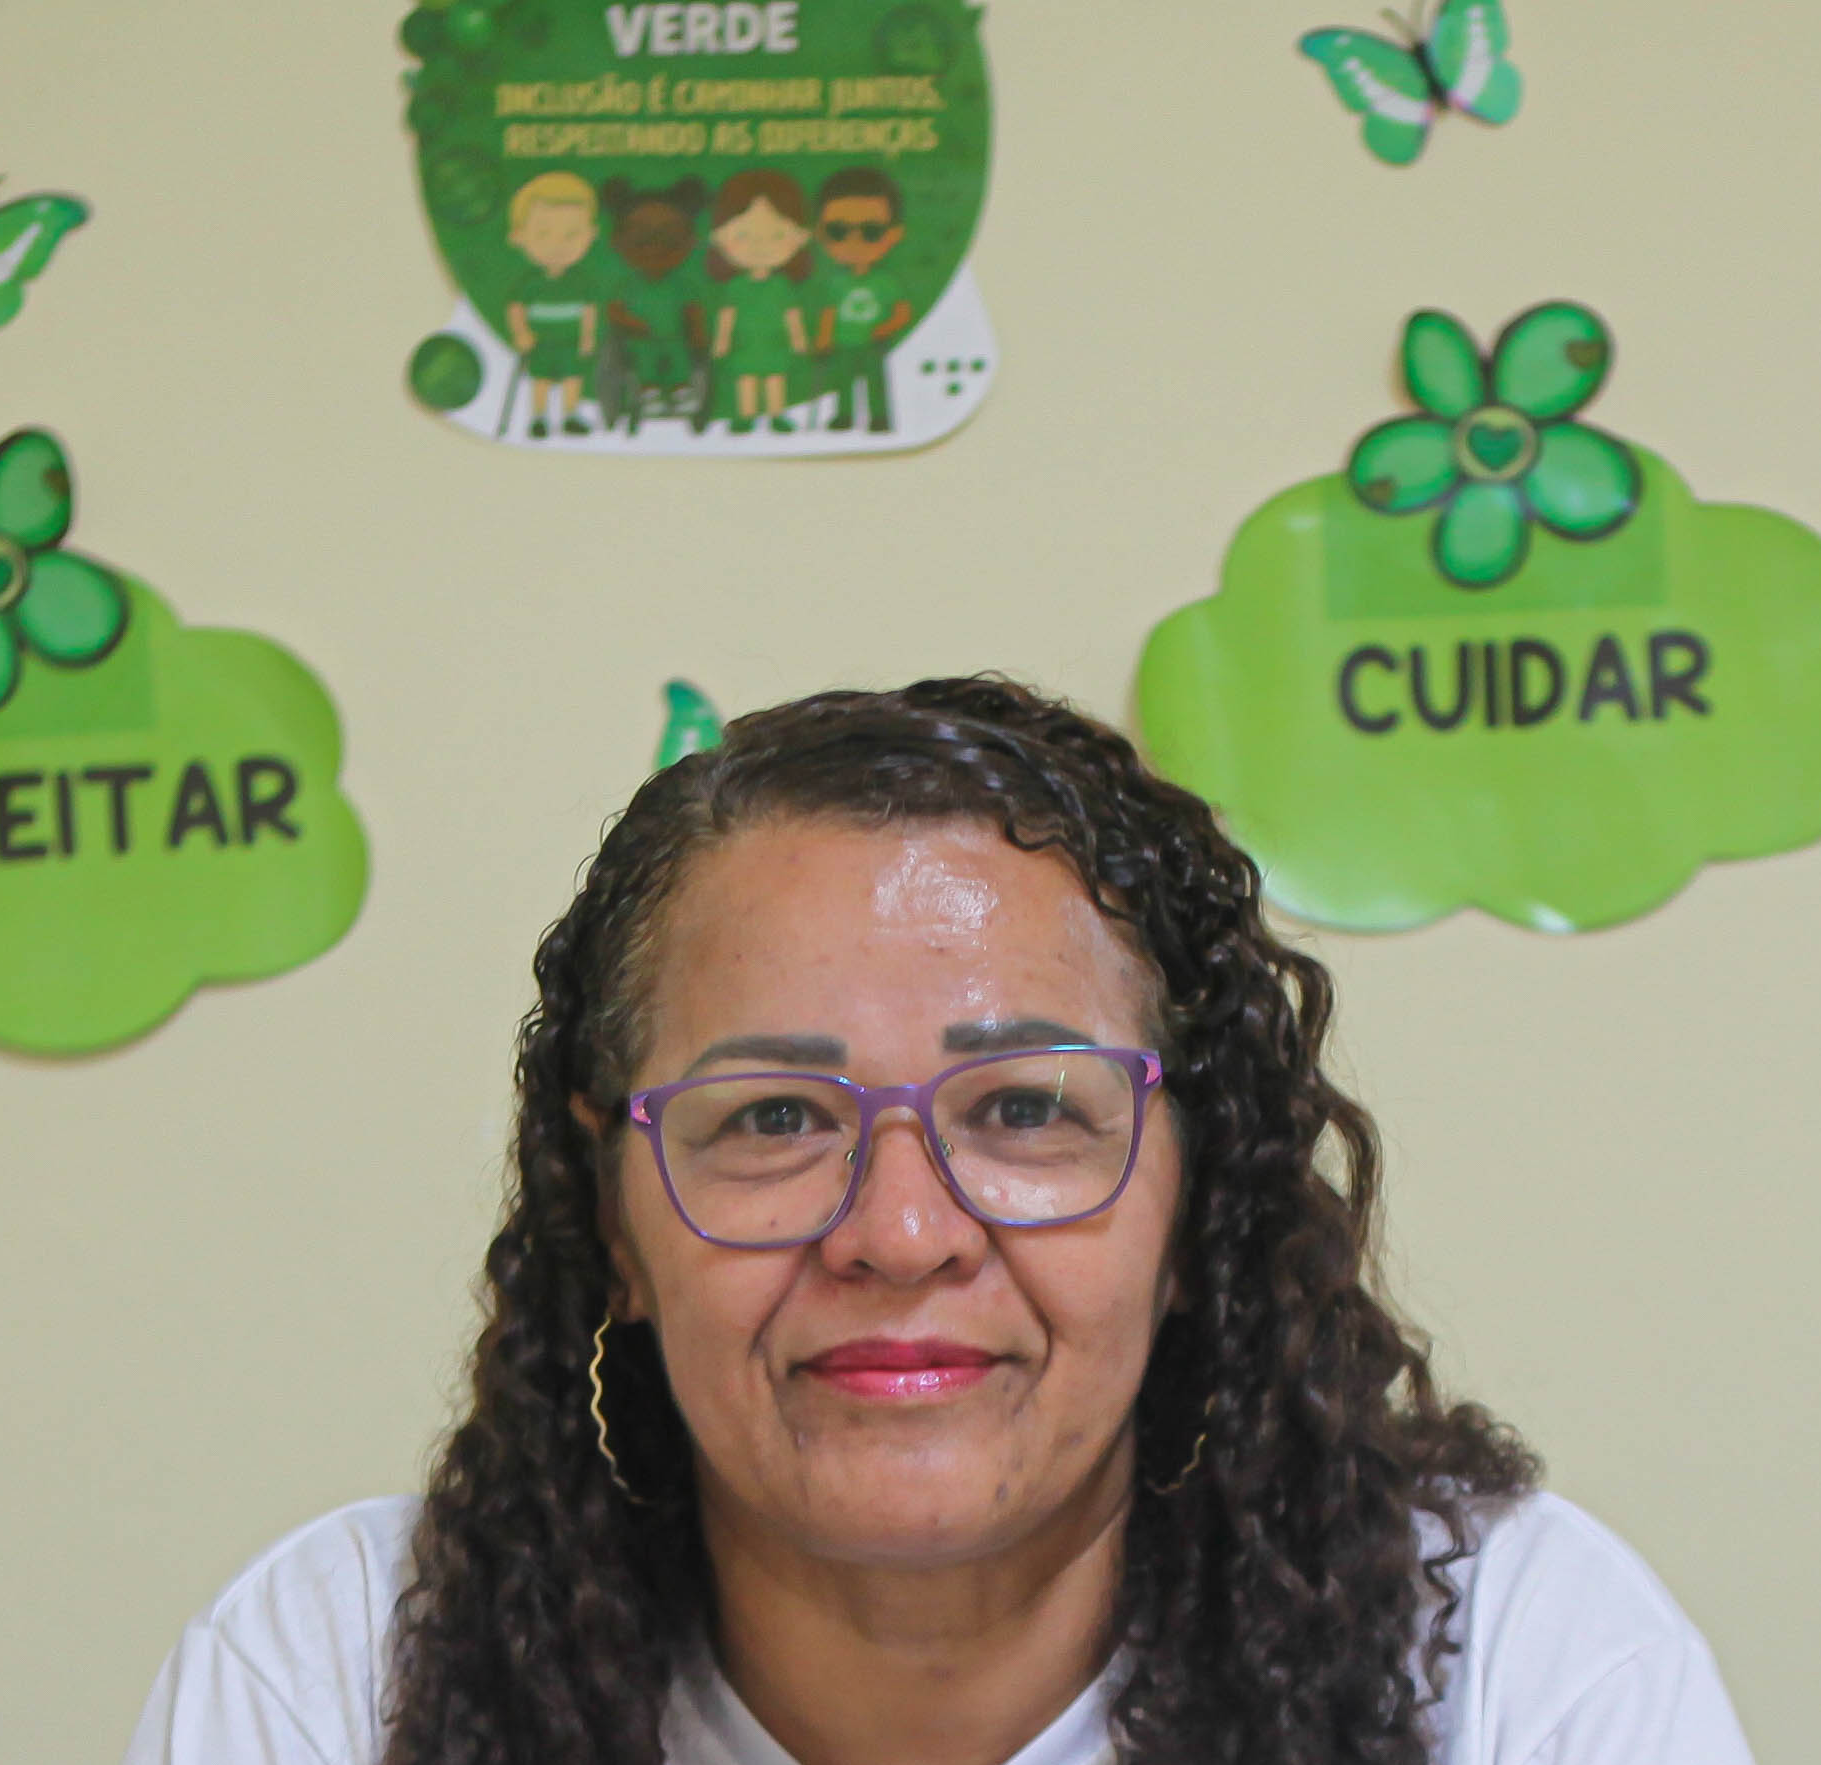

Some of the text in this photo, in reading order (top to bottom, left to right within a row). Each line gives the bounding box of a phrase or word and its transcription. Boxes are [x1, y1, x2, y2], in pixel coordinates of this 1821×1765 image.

[605, 2, 800, 57] VERDE
[495, 72, 643, 117] INCLUSÃO
[673, 78, 823, 115] CAMINHAR
[503, 118, 939, 159] RESPEITANDO AS DIFERENÇAS
[1335, 630, 1713, 737] CUIDAR
